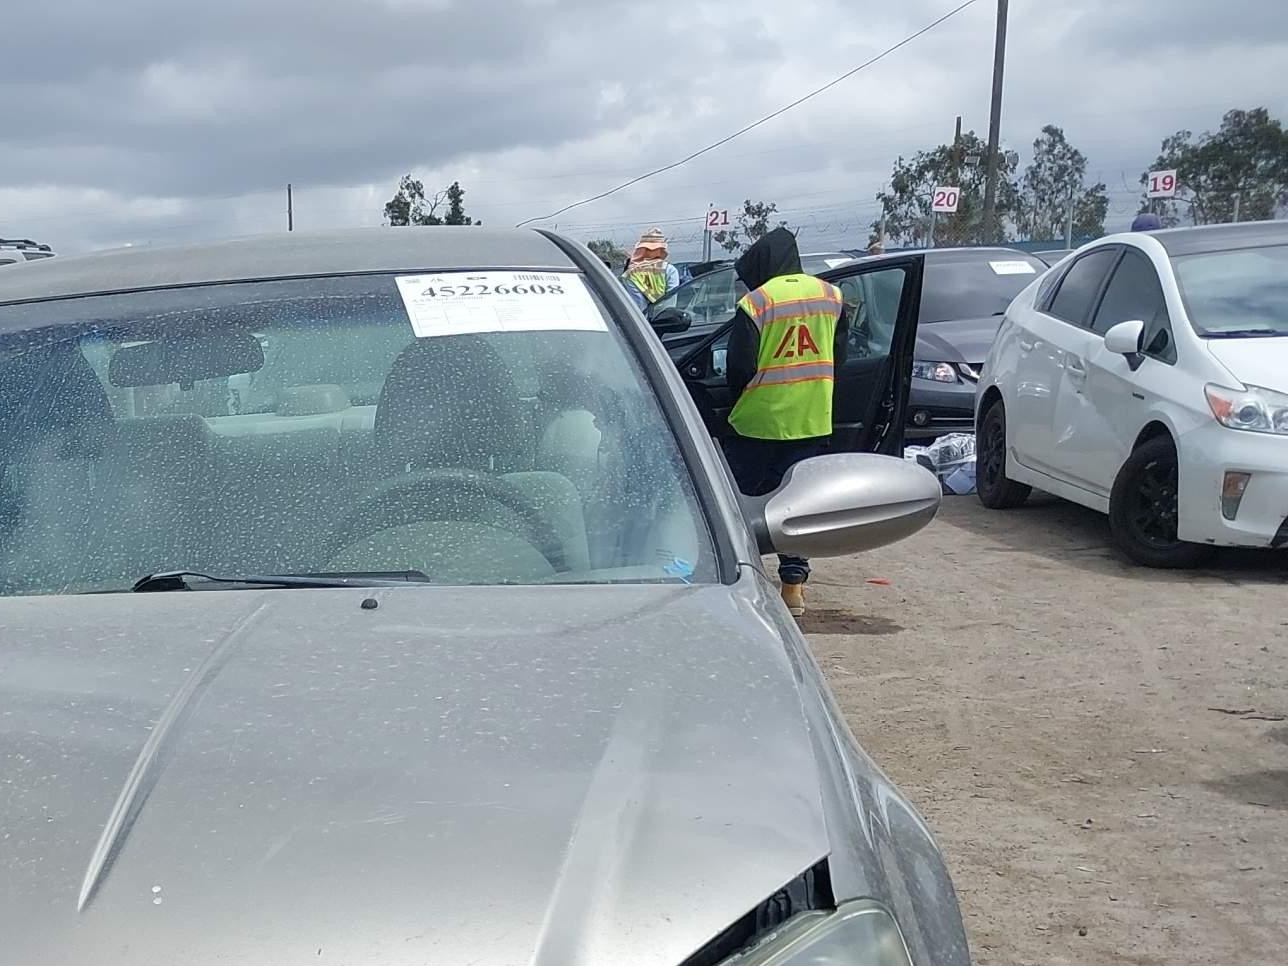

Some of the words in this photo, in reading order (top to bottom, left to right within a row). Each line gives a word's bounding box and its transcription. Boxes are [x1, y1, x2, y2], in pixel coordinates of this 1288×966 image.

[1149, 175, 1174, 192] 19
[934, 191, 957, 207] 20
[709, 210, 730, 226] 21
[421, 284, 565, 298] 45226608
